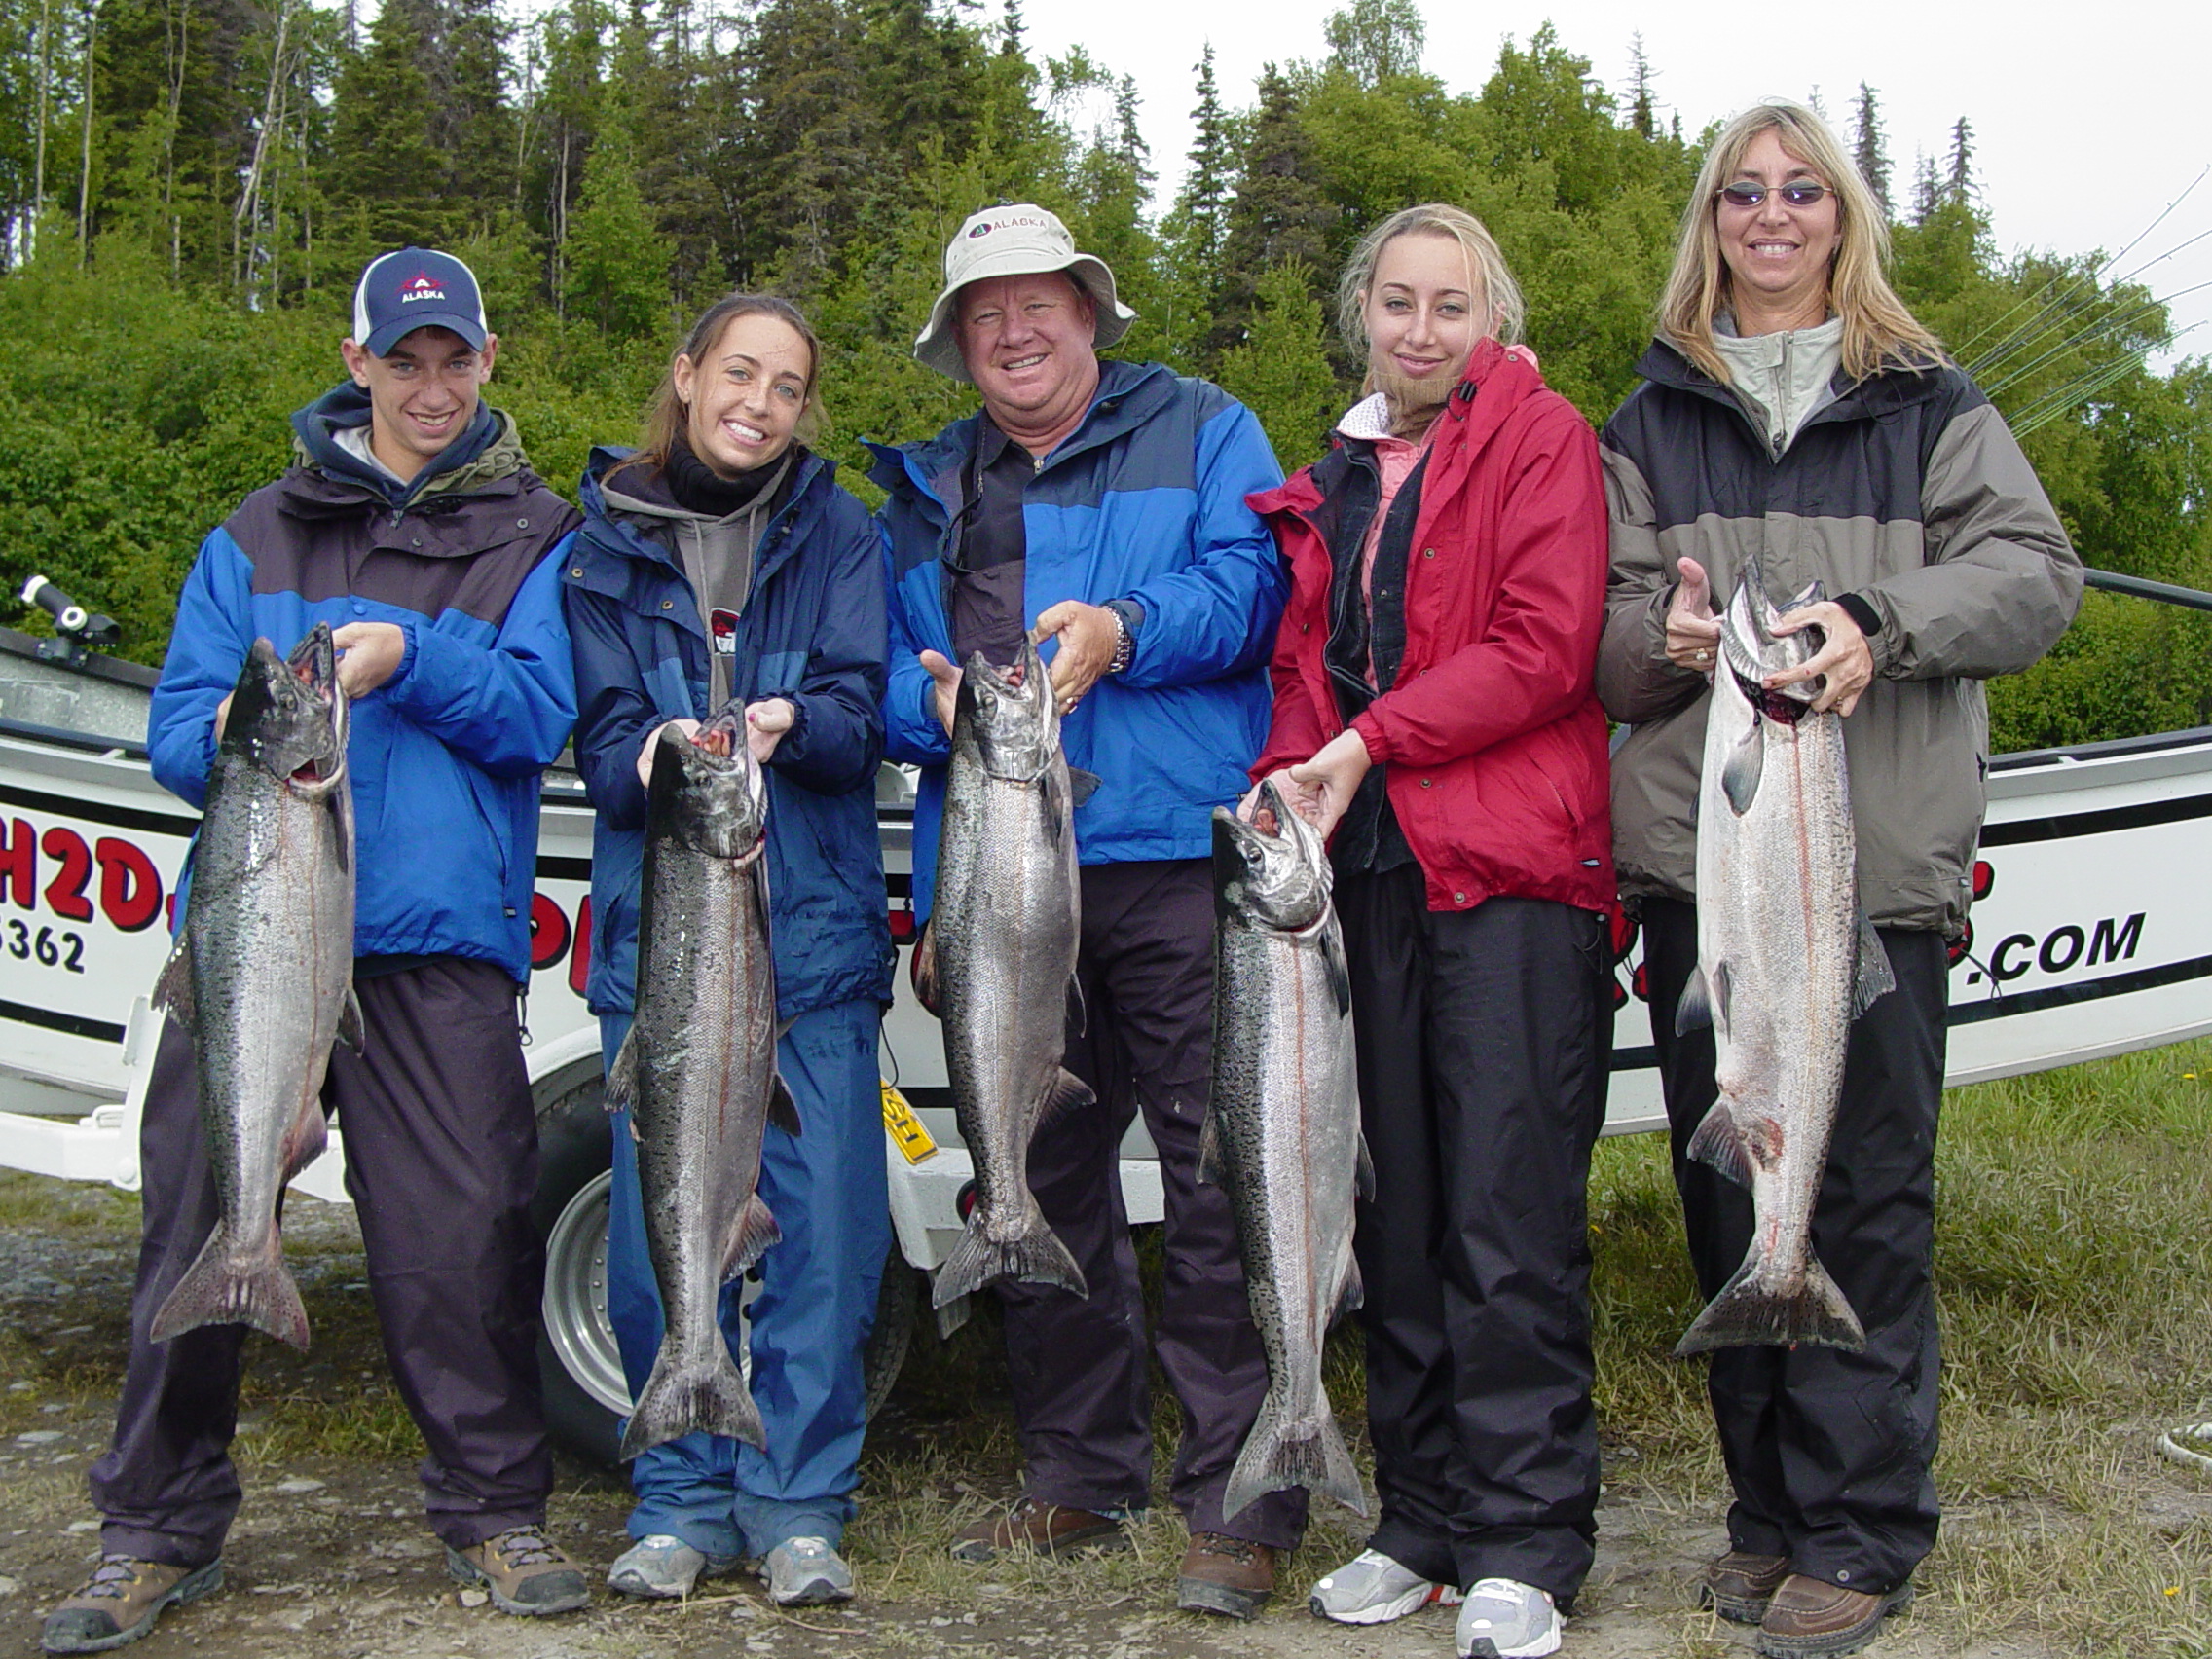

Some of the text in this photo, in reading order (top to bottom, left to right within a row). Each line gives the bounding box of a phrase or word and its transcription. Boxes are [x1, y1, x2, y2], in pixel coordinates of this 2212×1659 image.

[993, 217, 1047, 231] ALASKA
[402, 291, 445, 303] ALASKA
[0, 816, 175, 934] H2D
[0, 916, 85, 974] 362
[1967, 912, 2147, 986] .COM
